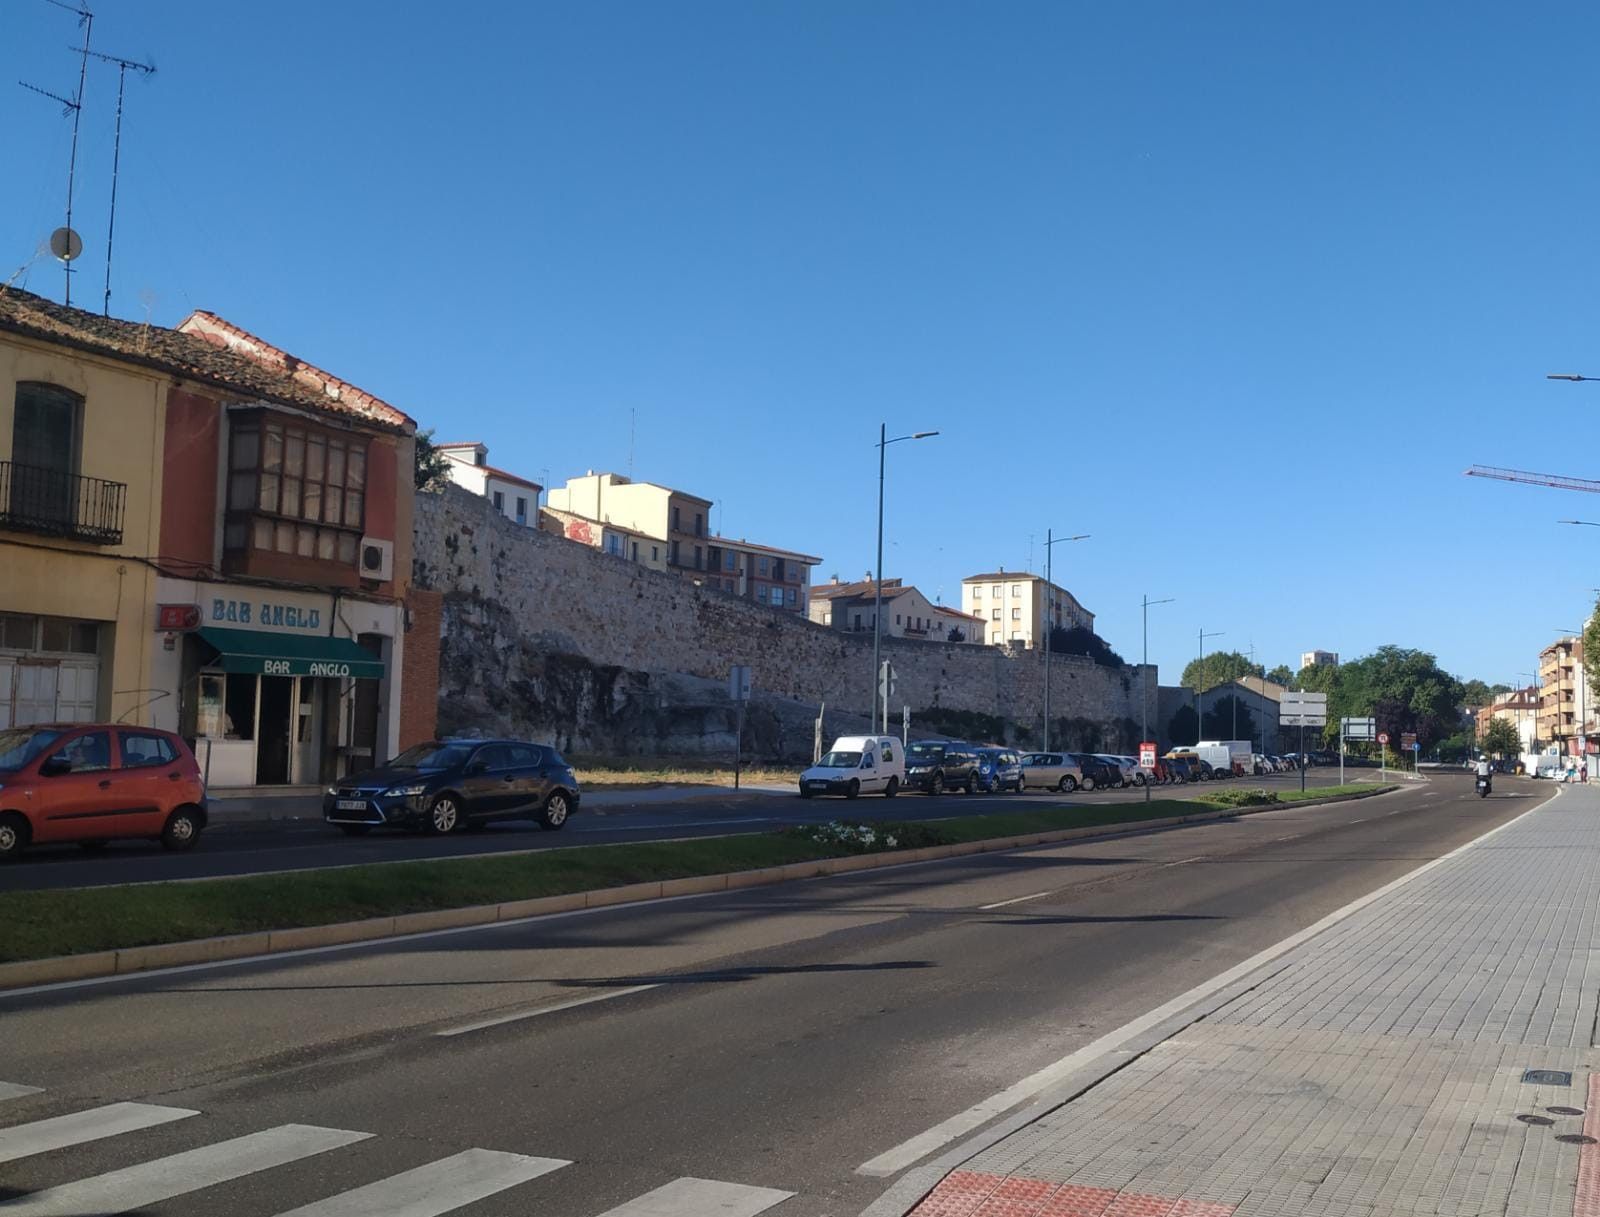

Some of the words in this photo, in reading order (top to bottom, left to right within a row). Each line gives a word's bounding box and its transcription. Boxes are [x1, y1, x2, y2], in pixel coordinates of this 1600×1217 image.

[213, 599, 251, 623] BAR
[260, 604, 320, 628] ANGLO
[264, 660, 290, 674] BAR
[310, 662, 349, 676] ANGLO
